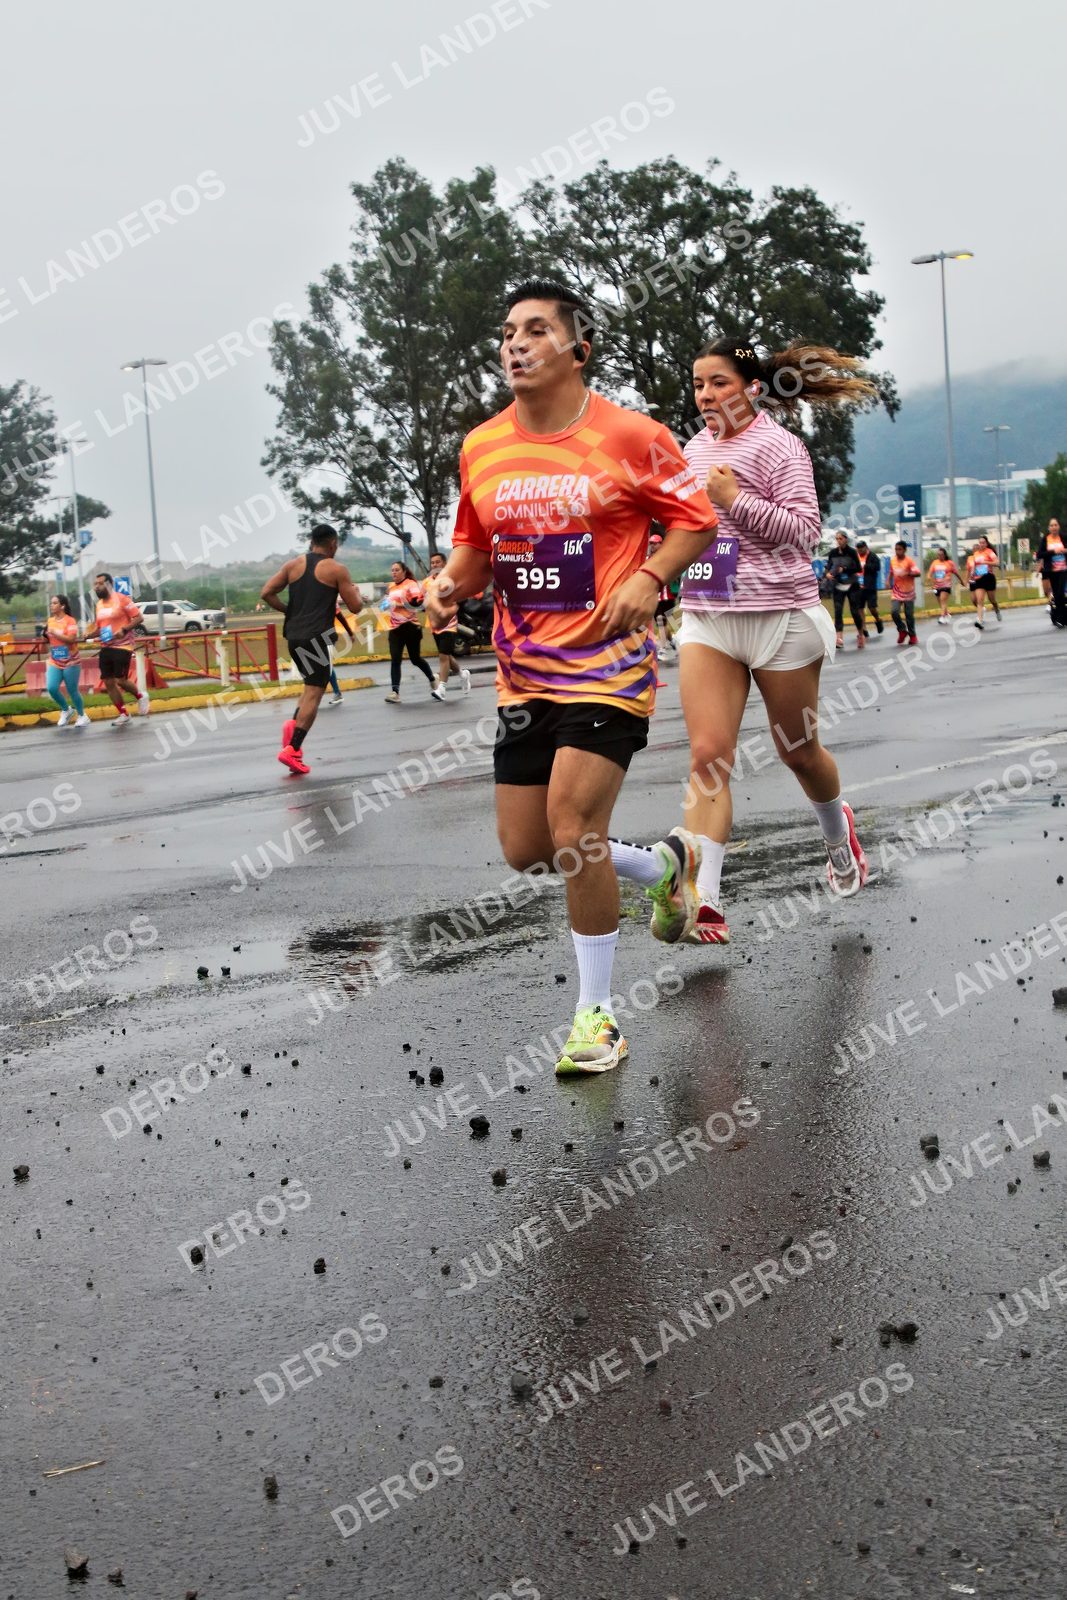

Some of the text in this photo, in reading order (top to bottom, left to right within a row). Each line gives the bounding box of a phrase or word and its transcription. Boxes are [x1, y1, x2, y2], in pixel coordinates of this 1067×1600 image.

[495, 474, 590, 503] CARRERA
[903, 500, 917, 518] E
[497, 541, 534, 554] CARRERA
[563, 540, 584, 556] 15K
[716, 542, 732, 555] 15K
[515, 567, 561, 590] 395
[687, 562, 713, 580] 699
